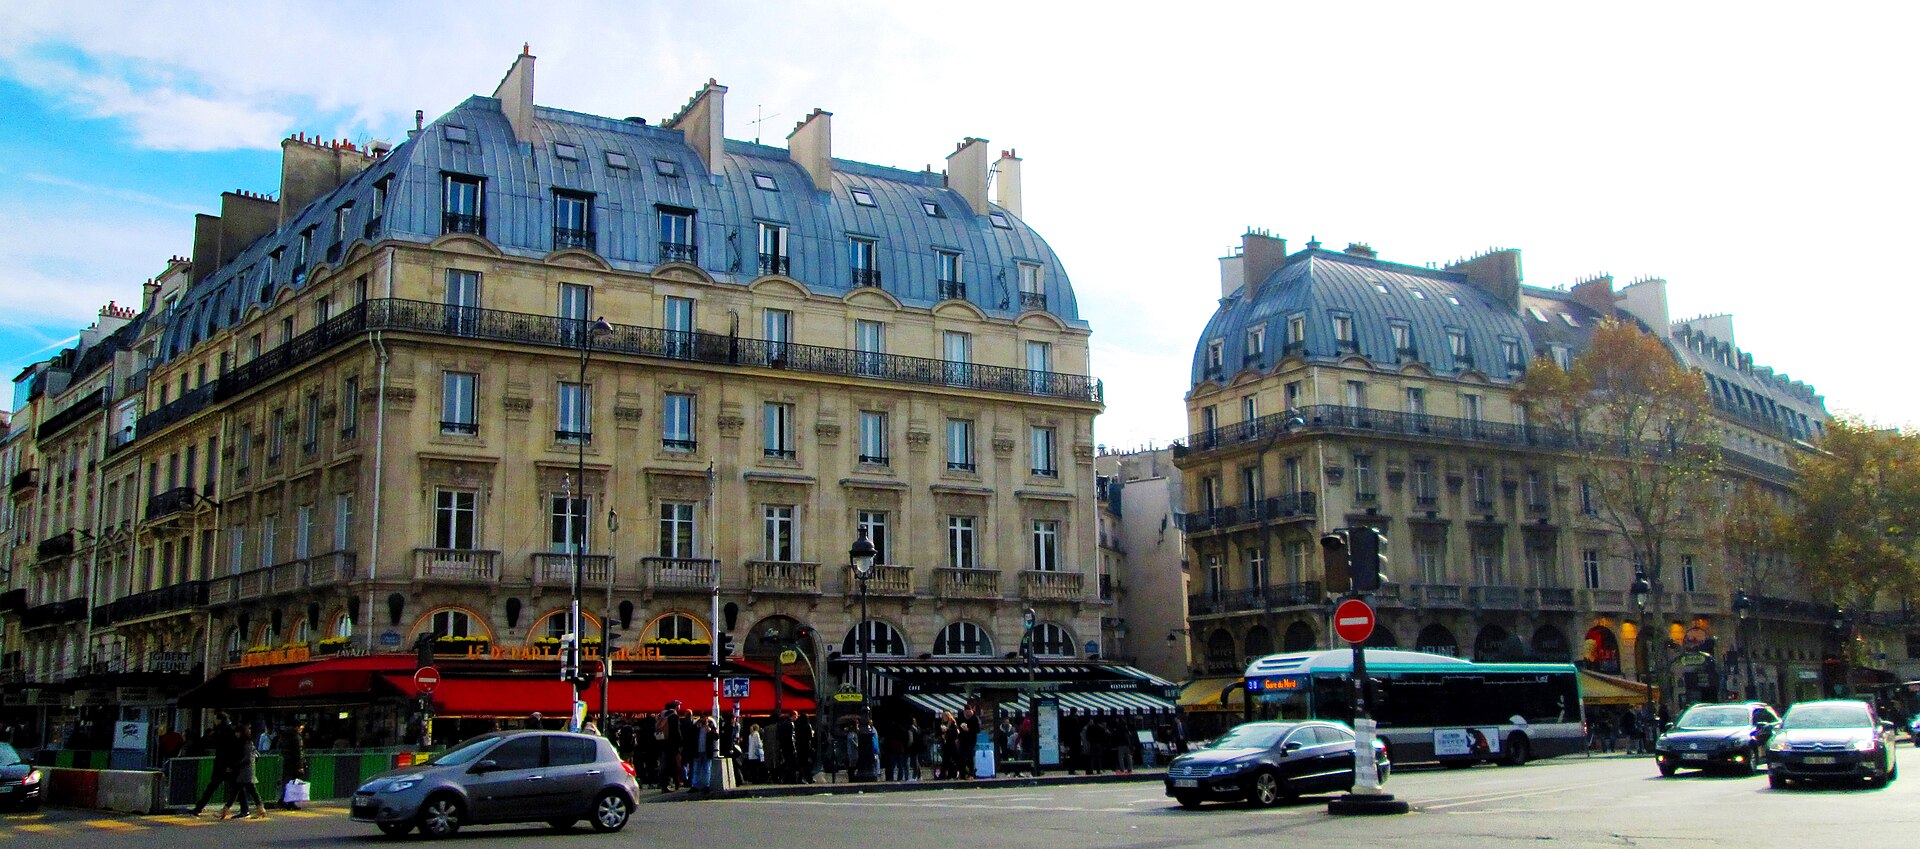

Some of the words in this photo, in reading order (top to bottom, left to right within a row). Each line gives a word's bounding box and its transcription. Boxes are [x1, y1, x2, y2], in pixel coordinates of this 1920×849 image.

[336, 647, 371, 658] LAVAZZA
[468, 645, 484, 658] LE
[1265, 679, 1277, 689] Gare
[1283, 678, 1297, 688] Nord
